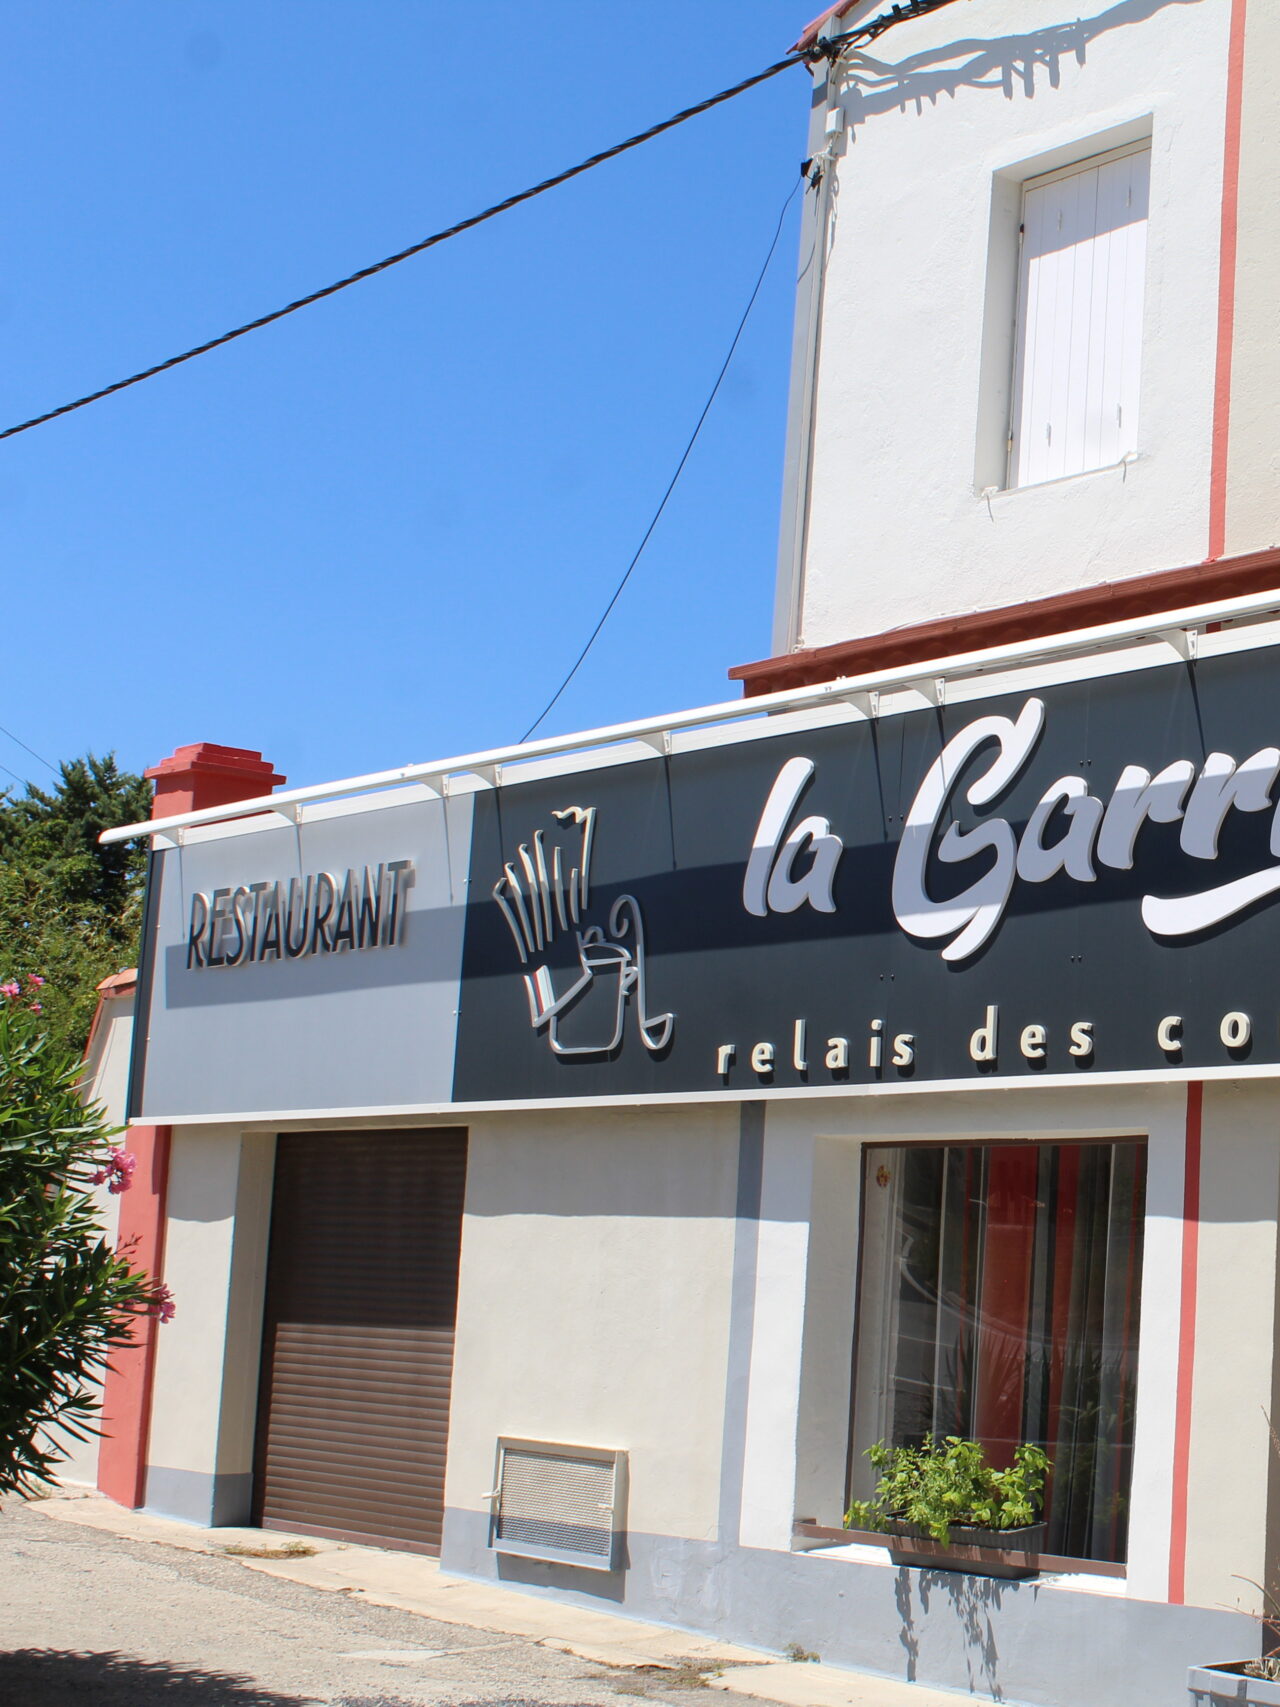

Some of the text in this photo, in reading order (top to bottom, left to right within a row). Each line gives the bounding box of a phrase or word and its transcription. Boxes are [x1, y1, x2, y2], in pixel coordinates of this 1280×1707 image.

[742, 757, 843, 916] la
[186, 860, 413, 969] RESTAURANT
[717, 1019, 915, 1074] relais
[969, 1005, 1093, 1061] des
